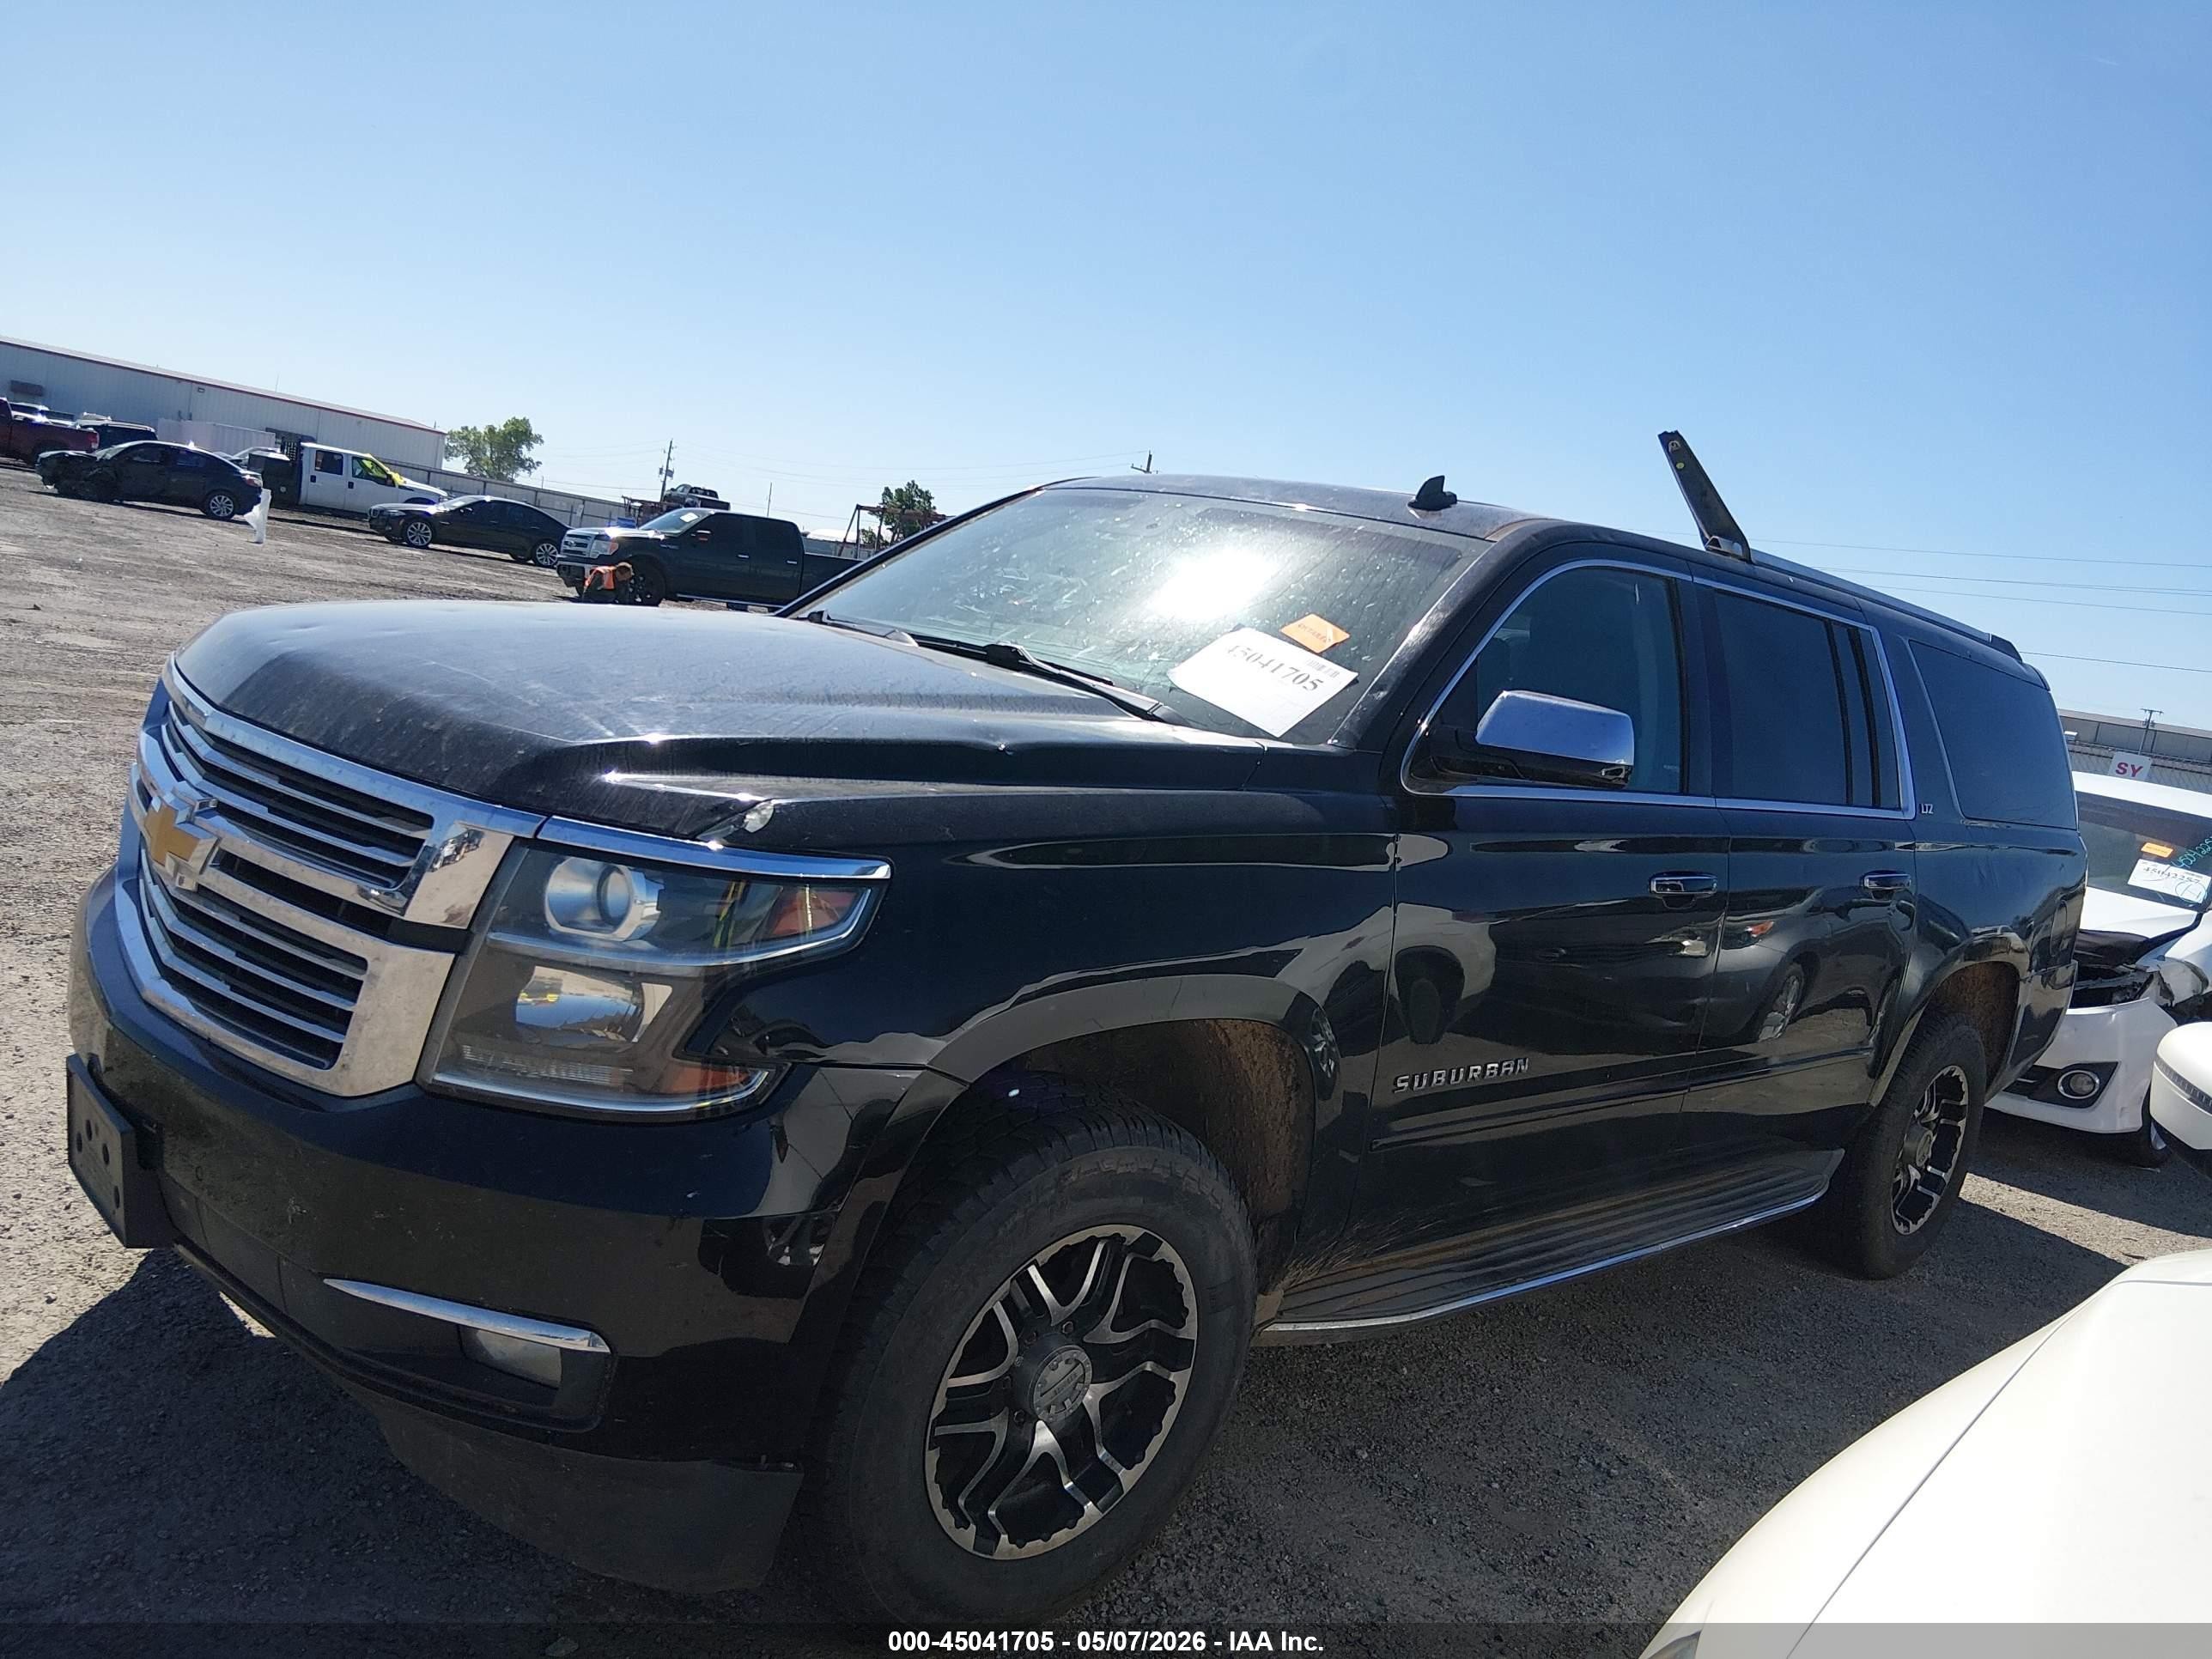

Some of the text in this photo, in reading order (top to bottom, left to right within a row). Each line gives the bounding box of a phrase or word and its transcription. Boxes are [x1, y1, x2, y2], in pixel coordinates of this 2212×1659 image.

[2115, 762, 2144, 778] SY
[1921, 803, 1934, 814] LTZ
[1394, 1057, 1530, 1094] SUBURBAN
